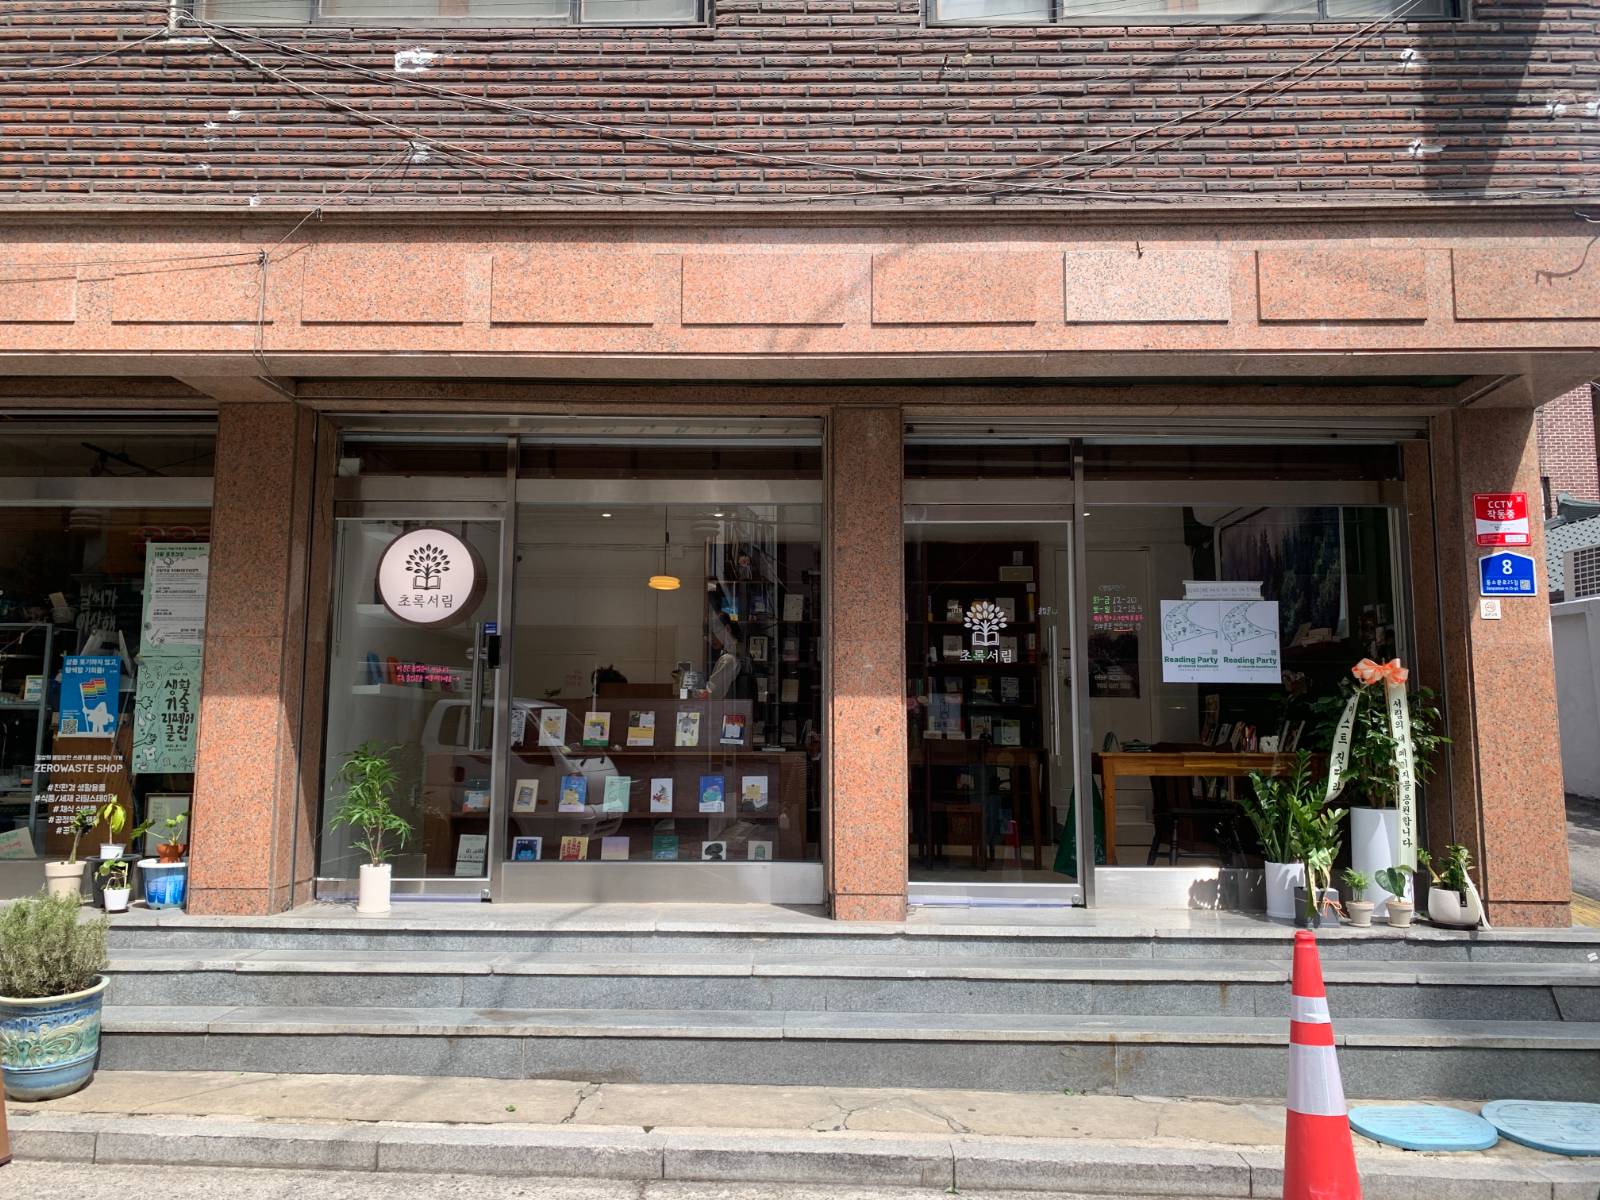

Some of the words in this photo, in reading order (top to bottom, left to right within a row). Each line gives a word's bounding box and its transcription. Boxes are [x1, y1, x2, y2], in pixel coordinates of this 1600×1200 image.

[1488, 500, 1513, 509] CCTV
[1487, 509, 1516, 520] 작동중
[1502, 559, 1513, 575] 8
[398, 594, 453, 609] 초록서림
[959, 649, 1012, 664] 초록서림
[1164, 656, 1196, 665] Reading
[1197, 656, 1218, 665] Party
[1223, 656, 1255, 665] Reading
[1256, 657, 1277, 665] Party
[164, 679, 191, 697] 생활
[166, 694, 190, 713] 기술
[161, 712, 195, 724] 리페어
[165, 724, 189, 742] 클럽
[34, 764, 94, 773] ZEROWASTE
[96, 764, 123, 773] SHOP
[1392, 698, 1405, 730] 서림의
[1402, 794, 1413, 848] 응원합니다
